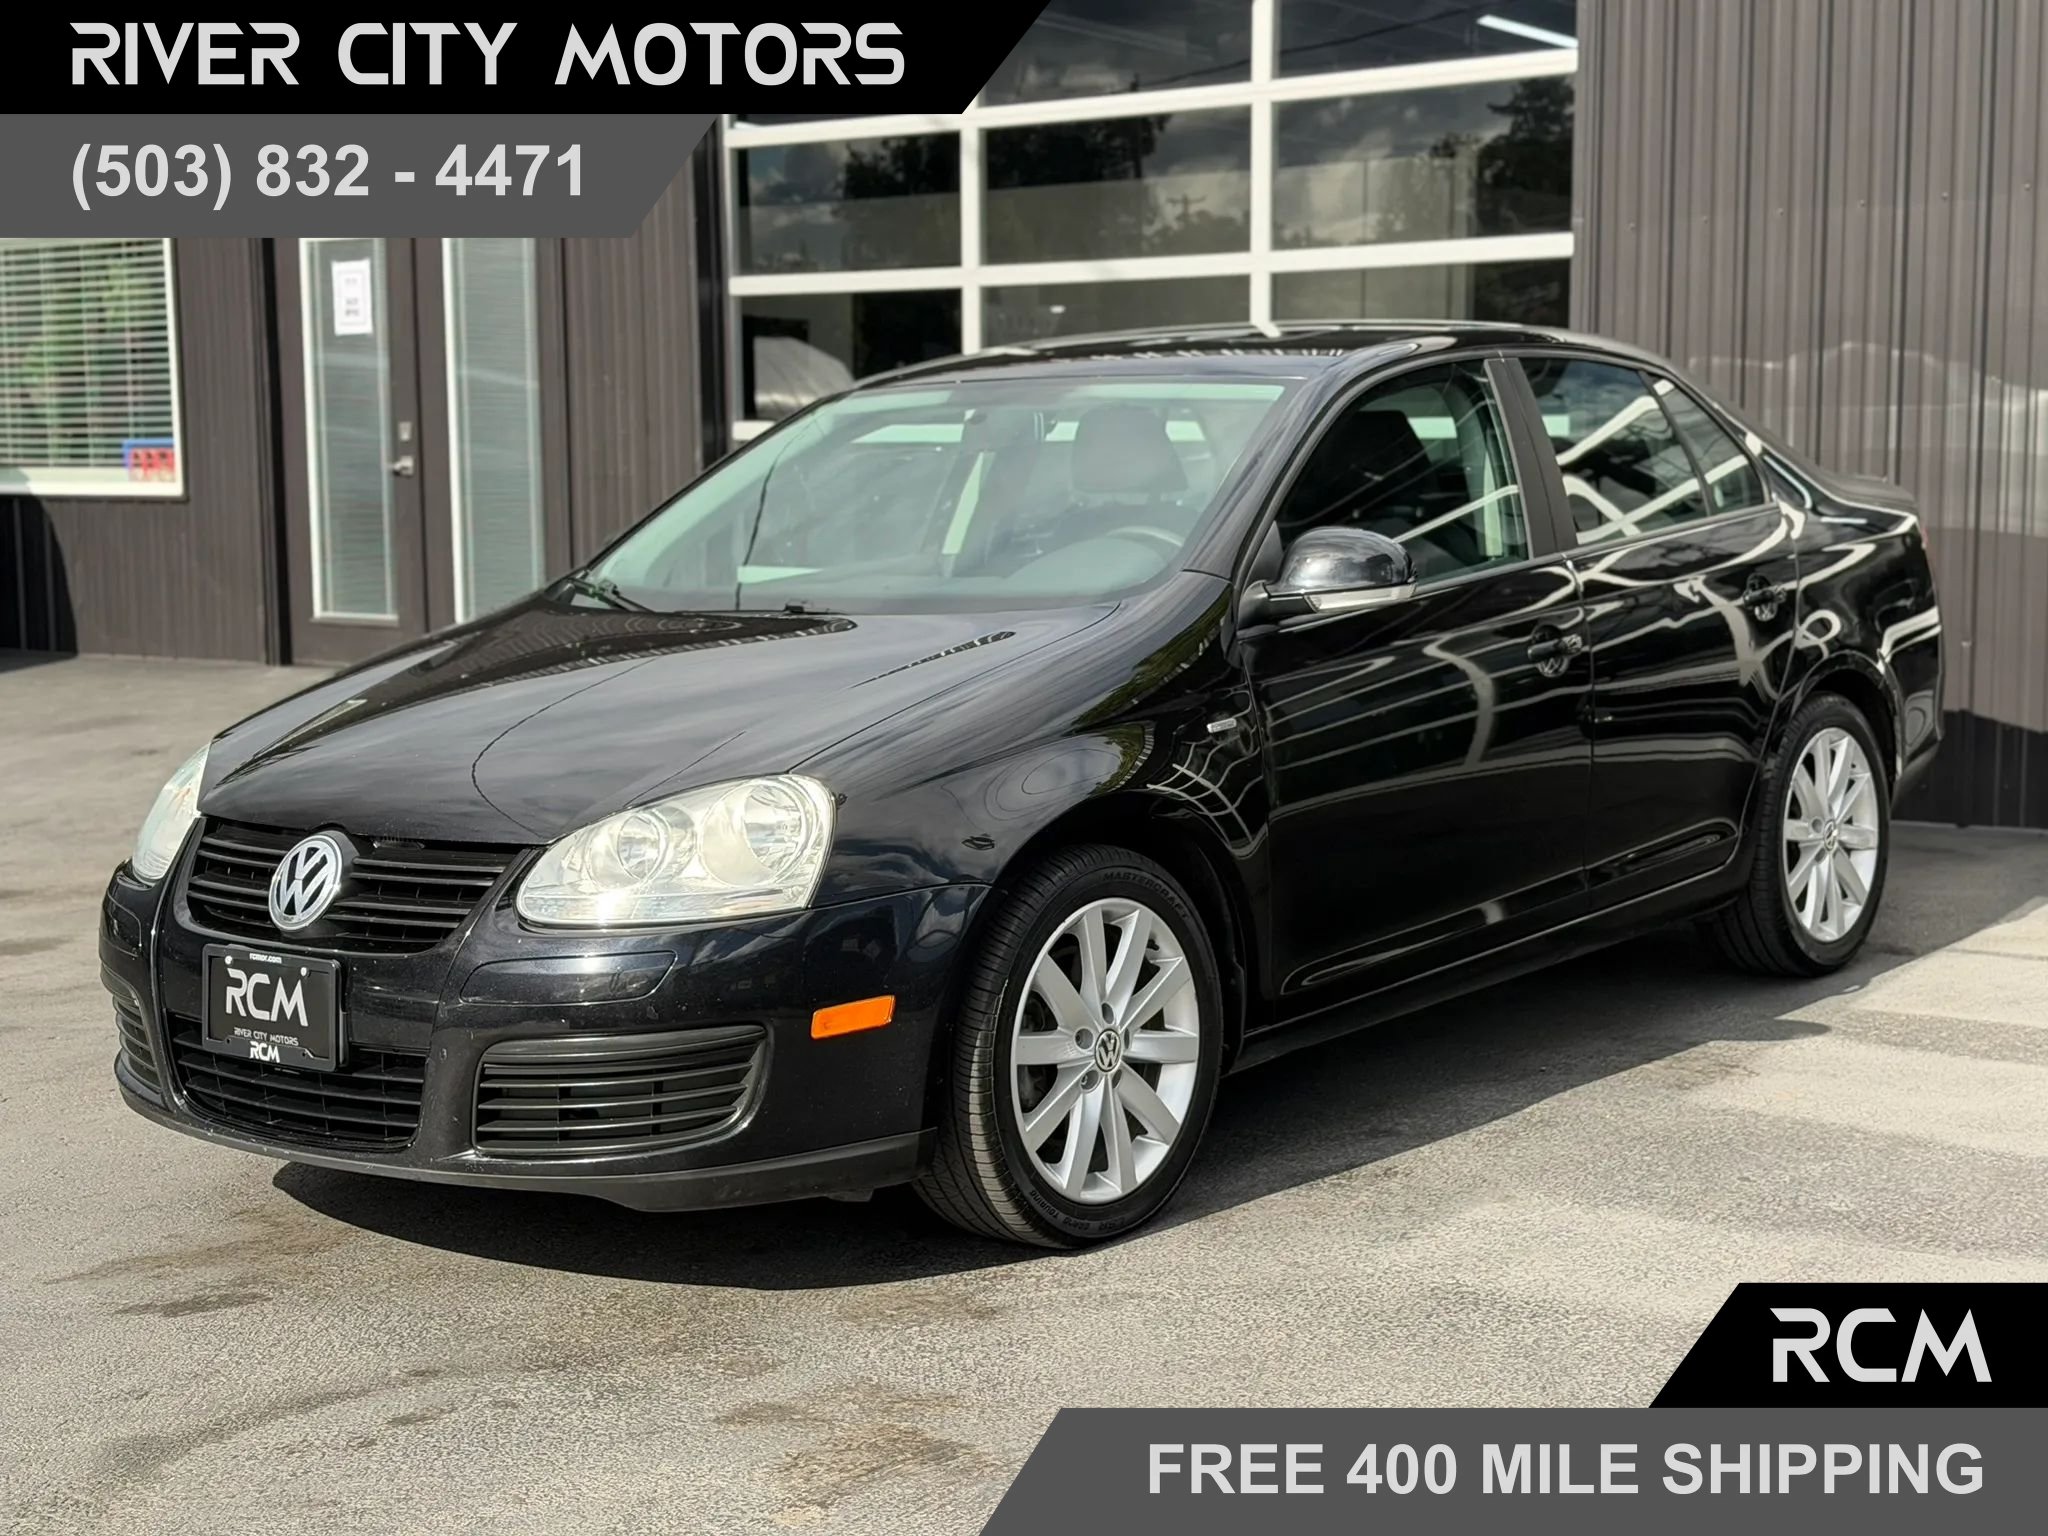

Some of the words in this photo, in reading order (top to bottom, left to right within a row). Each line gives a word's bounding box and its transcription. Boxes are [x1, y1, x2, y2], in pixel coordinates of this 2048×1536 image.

[1103, 871, 1189, 920] MASTERCRAFT
[225, 967, 309, 1027] RCM
[233, 1026, 252, 1039] RIVER
[253, 1030, 268, 1041] CITY
[269, 1034, 299, 1047] MOTORS
[249, 1040, 281, 1063] RCM
[1030, 1190, 1059, 1219] TOURING
